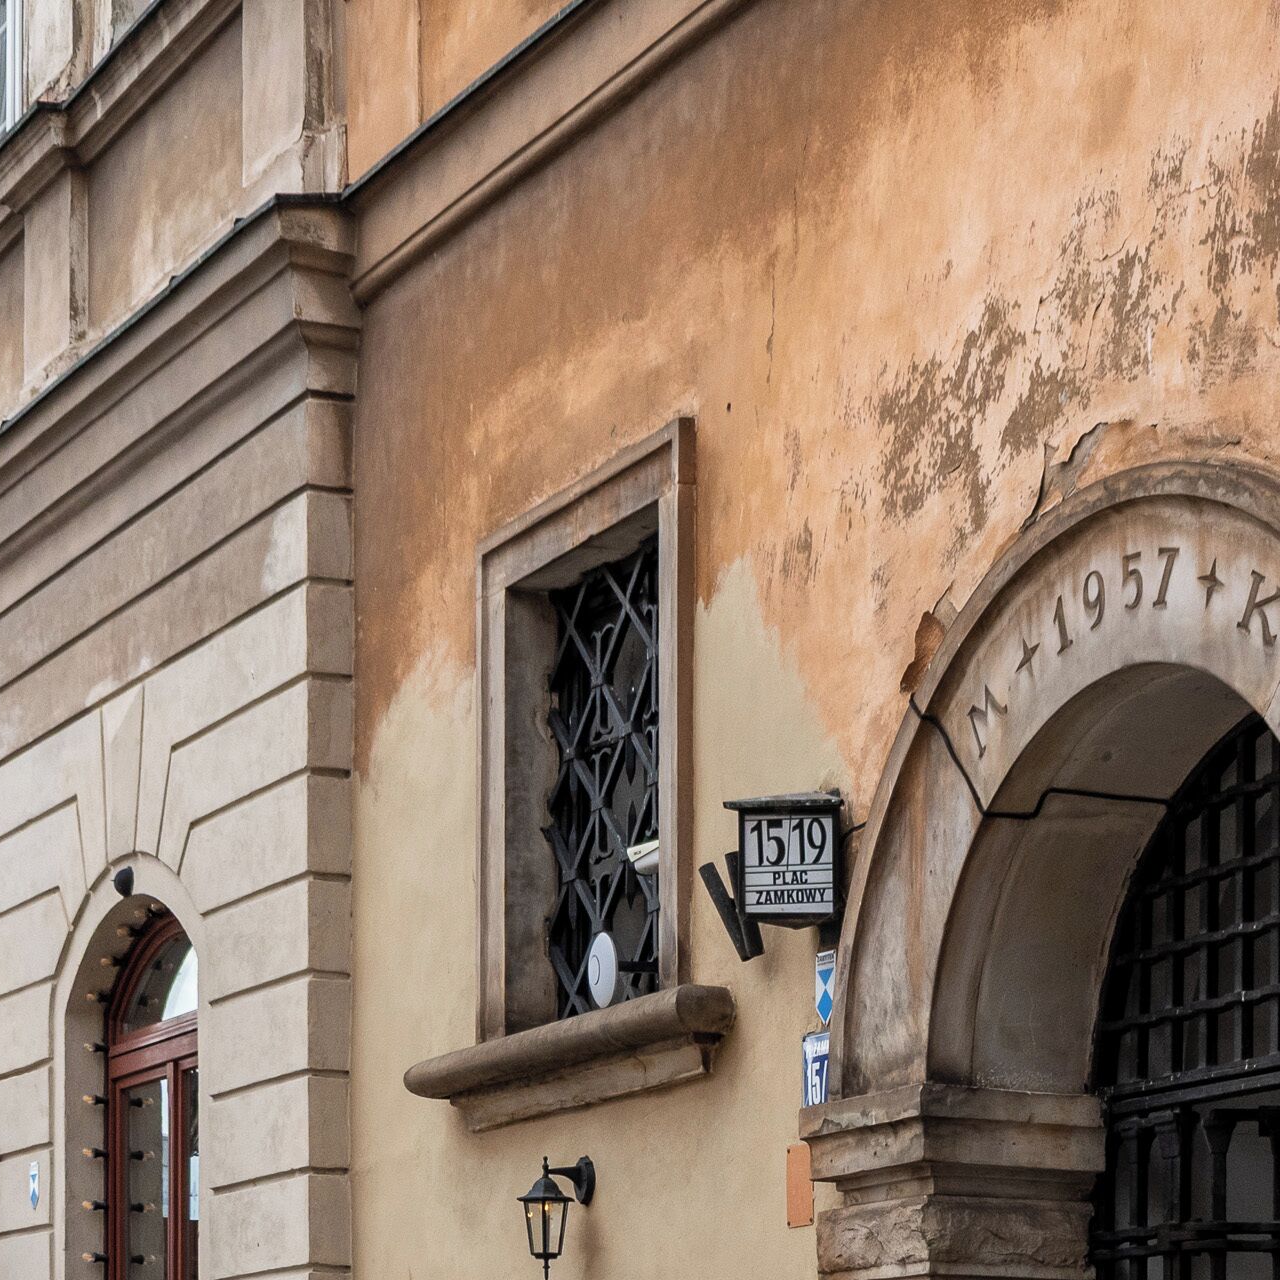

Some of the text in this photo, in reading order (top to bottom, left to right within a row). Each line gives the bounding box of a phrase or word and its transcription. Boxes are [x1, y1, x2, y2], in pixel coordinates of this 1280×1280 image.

[966, 685, 1008, 759] M
[1050, 547, 1181, 656] 1957
[772, 870, 808, 886] PLAC
[755, 887, 826, 905] ZAMKOWY
